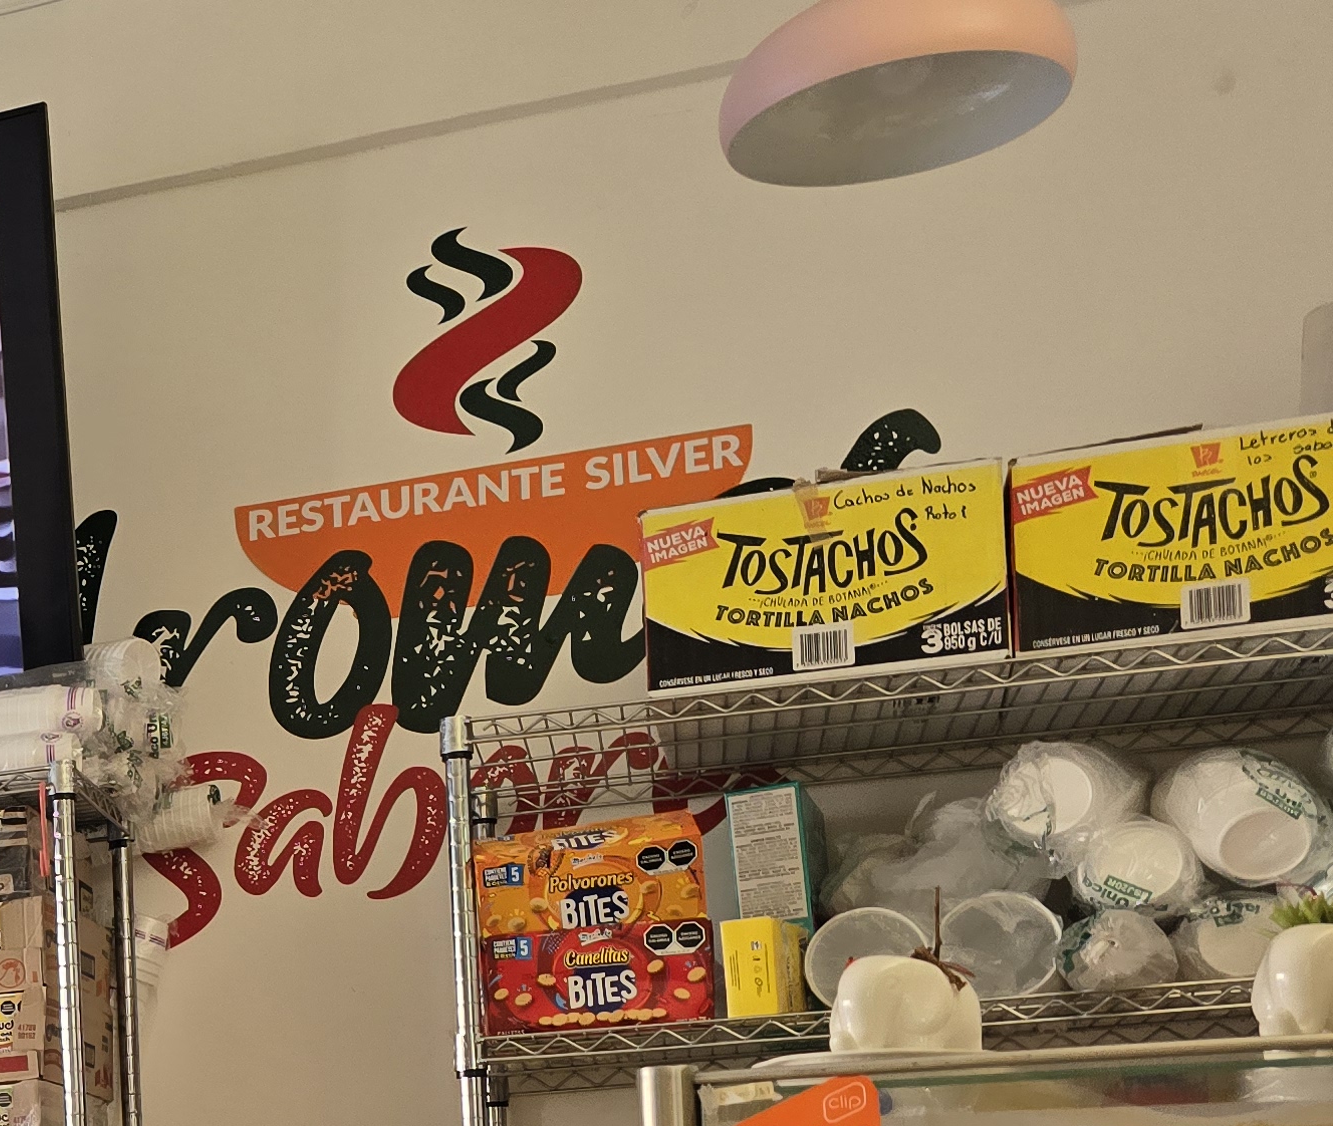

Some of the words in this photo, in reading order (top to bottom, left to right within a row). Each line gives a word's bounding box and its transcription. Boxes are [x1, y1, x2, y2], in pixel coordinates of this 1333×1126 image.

[247, 461, 566, 541] RESTAURANTE
[584, 433, 743, 492] SILVER
[833, 490, 890, 510] Cachos
[896, 482, 914, 498] de
[921, 476, 977, 496] Nachos
[1015, 474, 1084, 505] NUEVA
[1020, 486, 1086, 517] IMAGEN
[1093, 453, 1331, 549] TOSTACHOS
[646, 525, 707, 553] NUEVA
[649, 540, 709, 564] IMAGEN
[716, 507, 929, 596] TOSTACHOS
[1093, 558, 1217, 584] TORTILLA
[1223, 527, 1333, 578] NACHOS
[1201, 549, 1216, 560] DE
[715, 604, 827, 629] TORTILLA
[831, 577, 935, 624] NACHOS
[813, 594, 825, 606] DE
[943, 619, 986, 638] BOLSAS
[988, 616, 1003, 632] DE
[1091, 630, 1112, 643] LUGAR
[1142, 624, 1160, 636] SECO
[921, 628, 944, 654] 3
[943, 635, 966, 651] 950
[967, 637, 977, 651] g
[979, 630, 1003, 647] C/U
[510, 866, 521, 882] 5
[549, 871, 634, 893] Polvorones
[560, 890, 631, 930] BITES
[519, 941, 530, 956] 5
[564, 947, 630, 968] Canelitas
[567, 968, 638, 1010] BITES
[828, 1094, 862, 1110] clip
